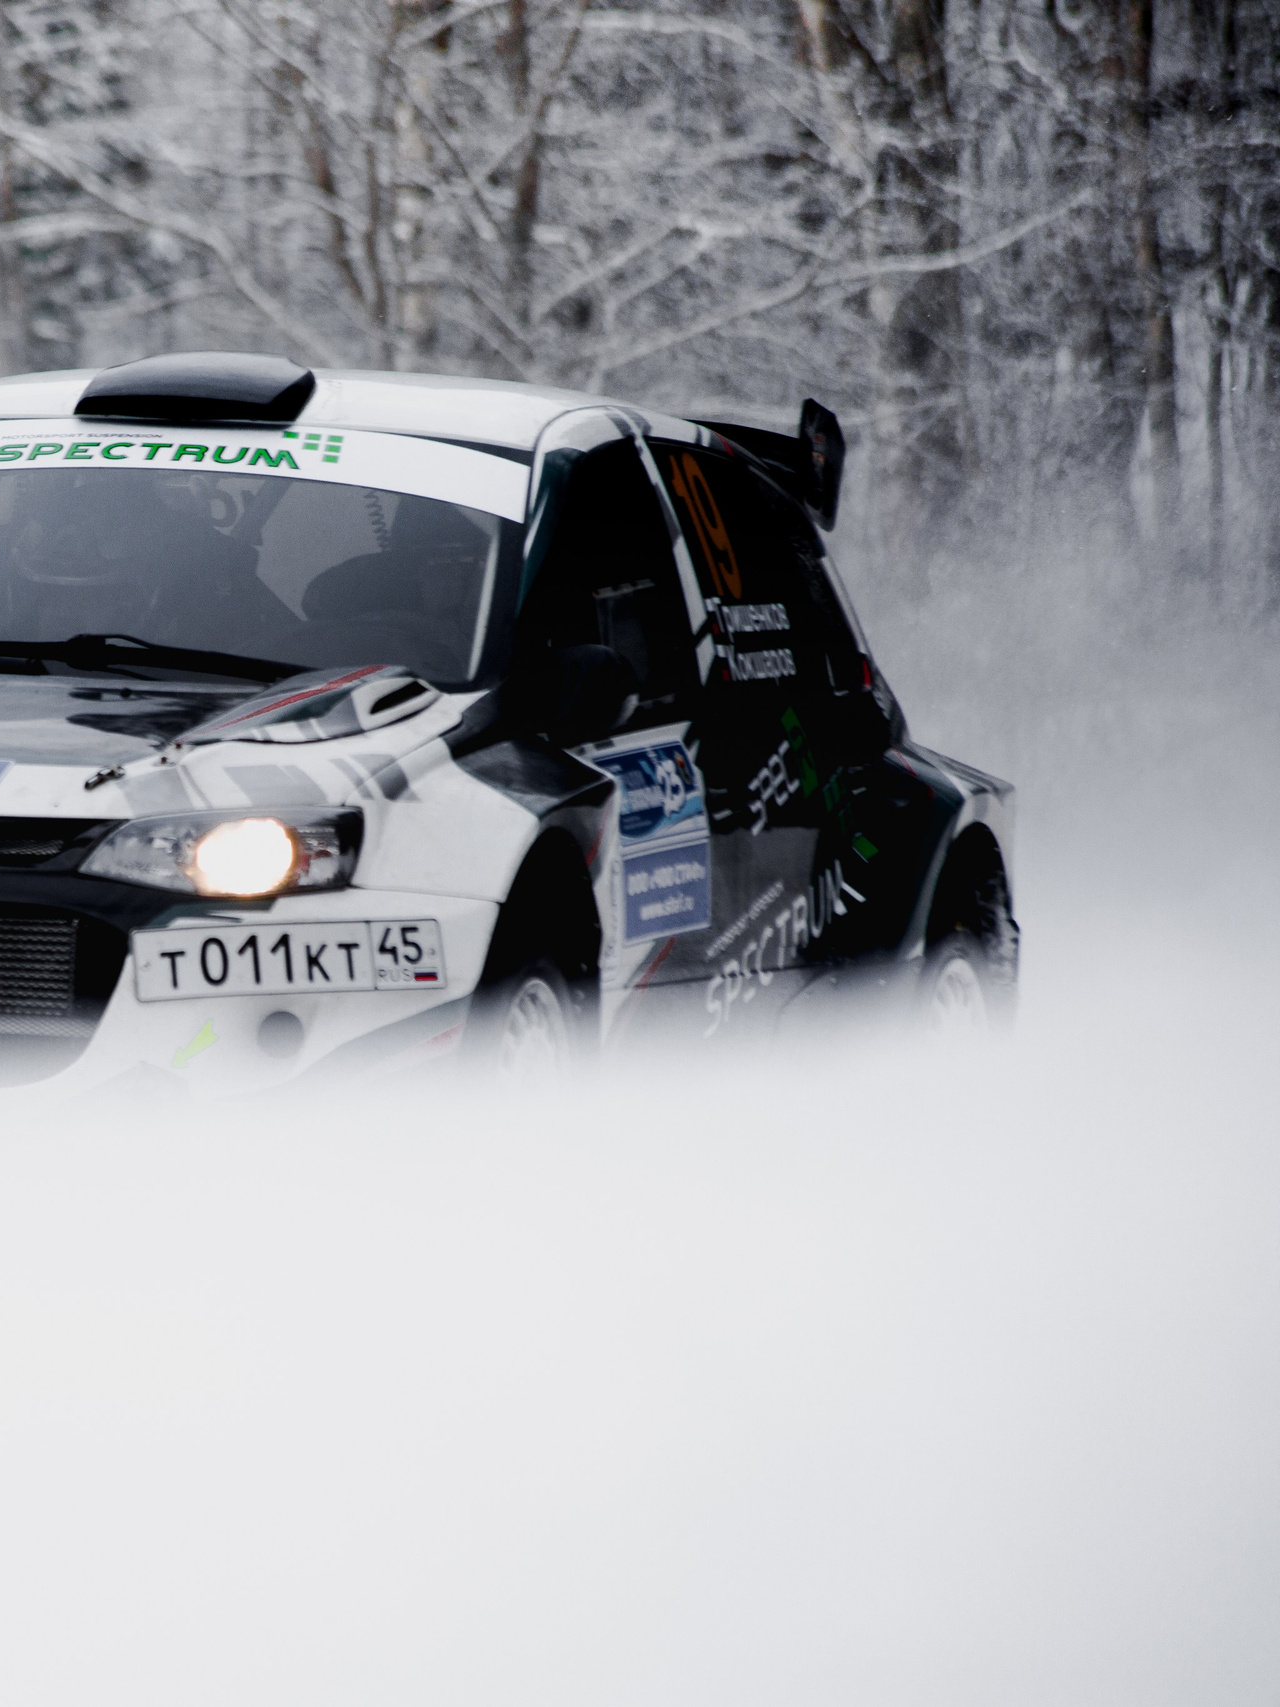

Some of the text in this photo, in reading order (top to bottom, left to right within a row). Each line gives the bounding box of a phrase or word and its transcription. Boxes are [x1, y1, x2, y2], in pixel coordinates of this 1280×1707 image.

[669, 453, 742, 598] 19
[377, 926, 424, 966] 45
[377, 967, 412, 983] RUS
